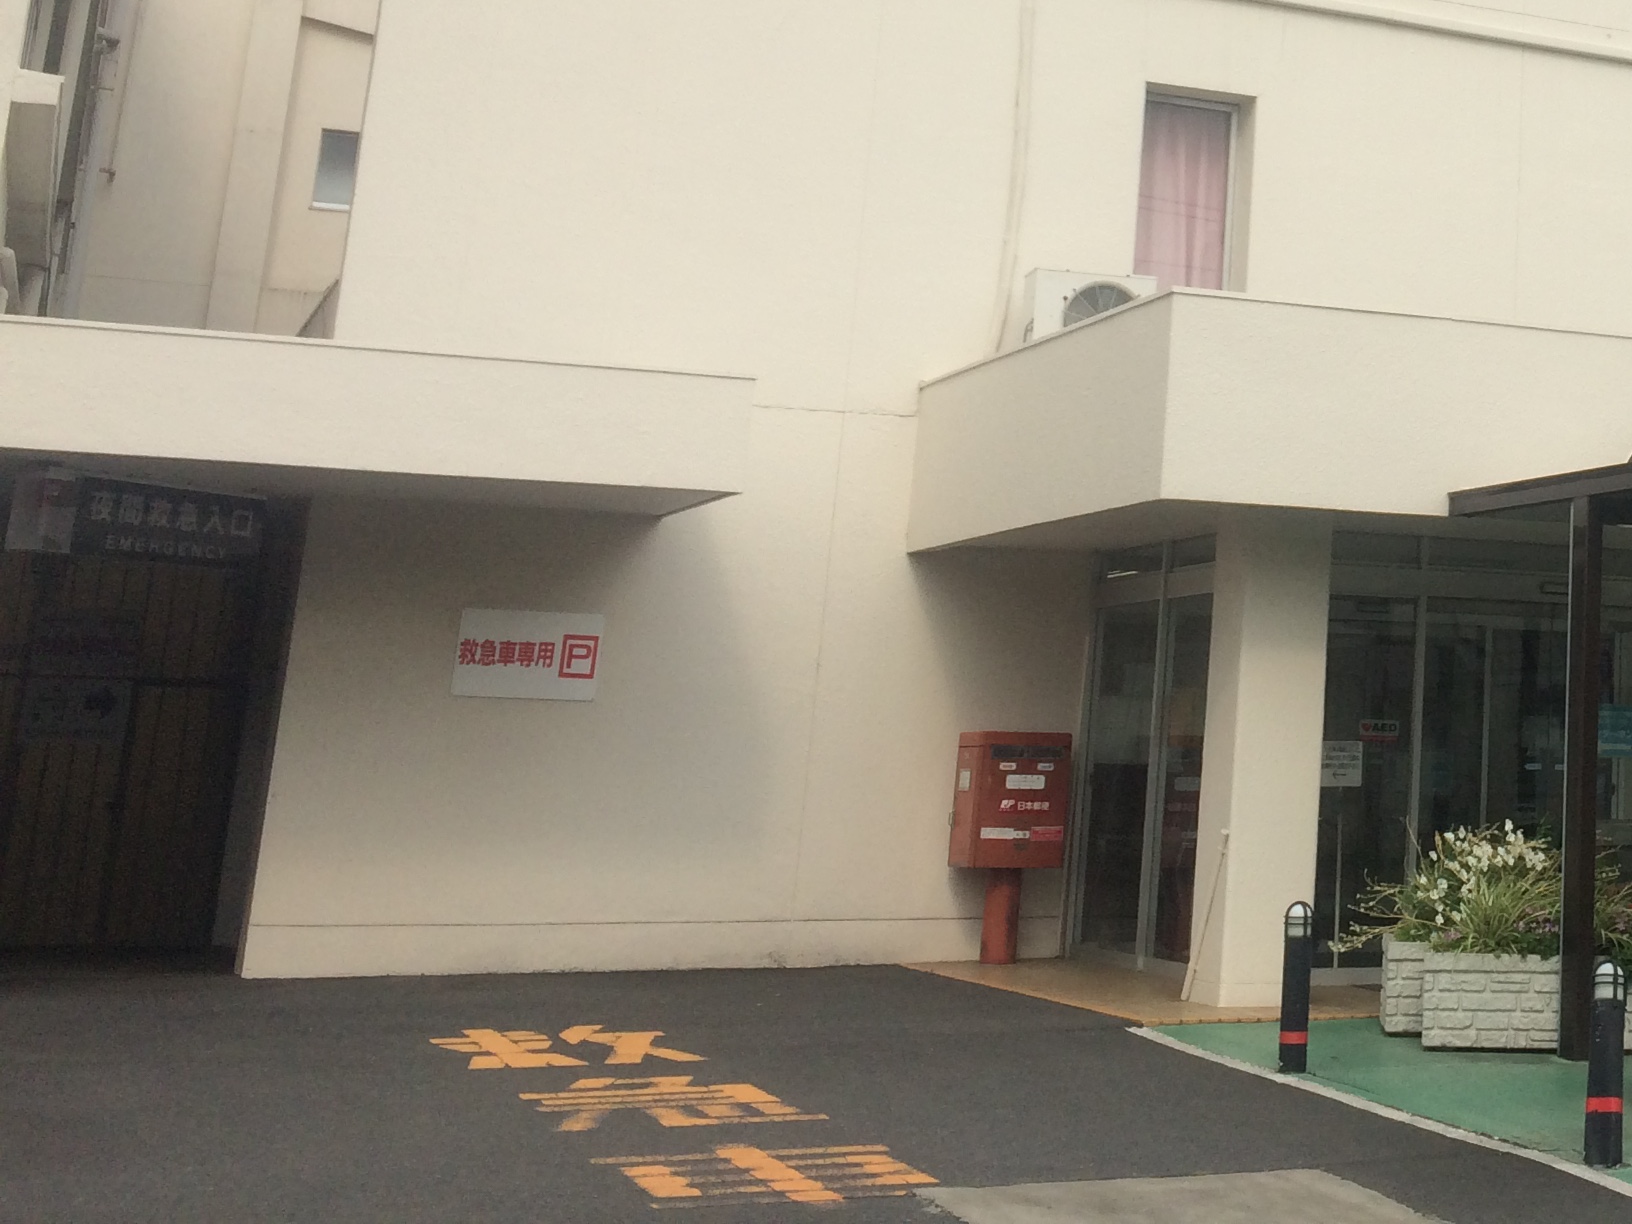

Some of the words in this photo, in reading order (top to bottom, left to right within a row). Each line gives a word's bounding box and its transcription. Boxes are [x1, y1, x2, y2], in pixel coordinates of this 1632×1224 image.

[458, 638, 556, 668] 救急車専用
[1372, 723, 1397, 732] AED
[428, 1024, 941, 1210] 救急車
